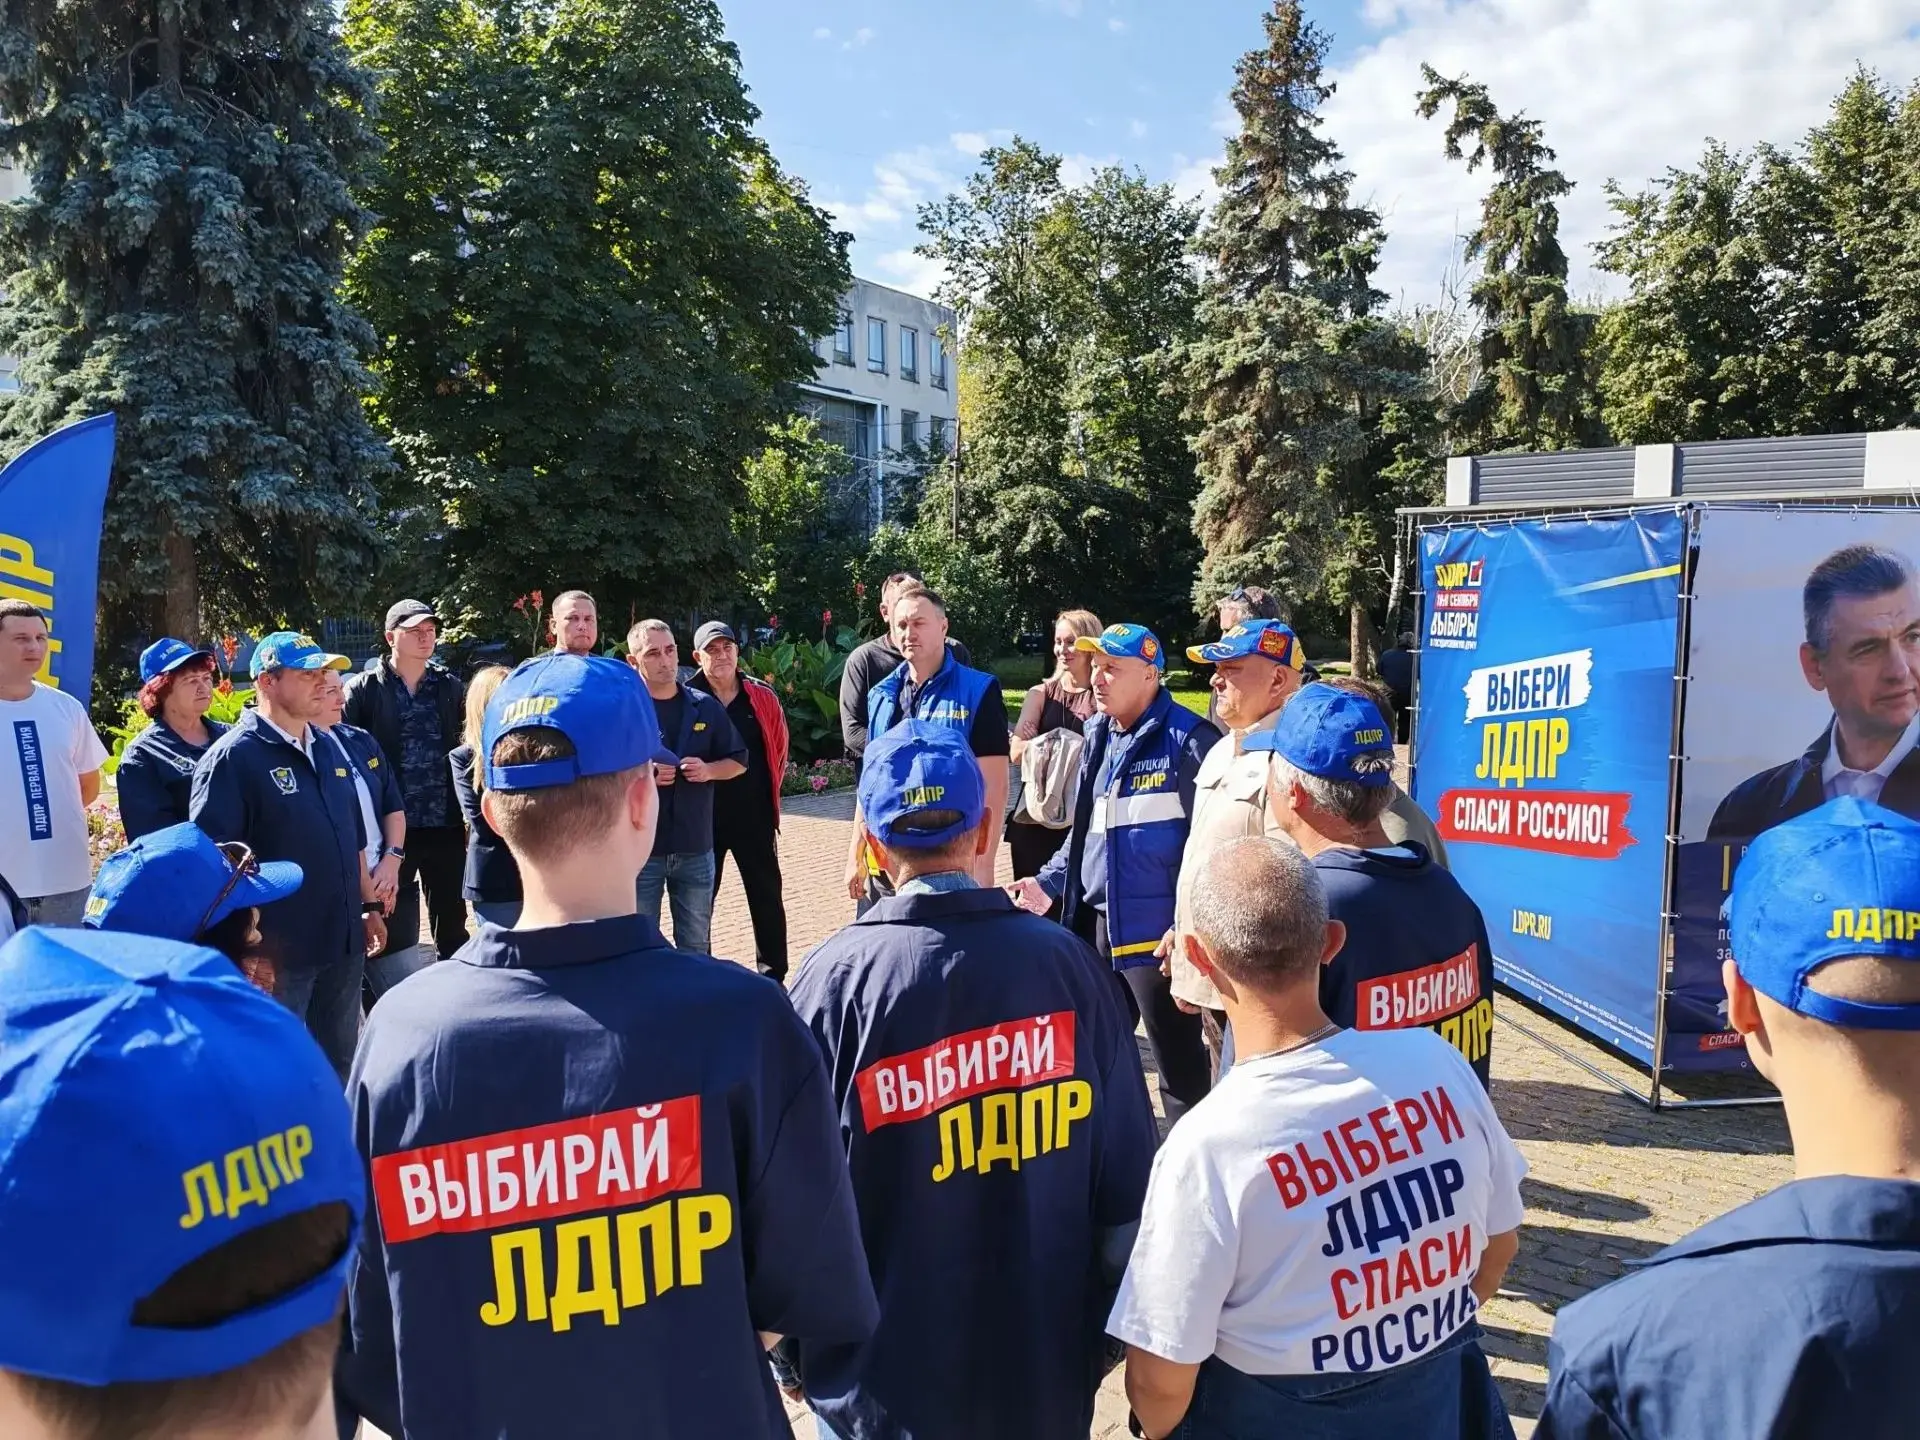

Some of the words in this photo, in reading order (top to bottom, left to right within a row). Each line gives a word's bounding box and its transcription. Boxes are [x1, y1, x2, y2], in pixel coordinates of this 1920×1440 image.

[1430, 611, 1479, 638] ВЫБОРЫ
[1486, 663, 1571, 712] ВЫБЕРИ
[500, 696, 558, 724] ЛДПР
[20, 726, 37, 763] ПАРТИЯ
[1354, 729, 1384, 745] ЛДПР
[1475, 717, 1570, 788] ЛДПР
[26, 763, 43, 799] ПЕРВАЯ
[1130, 755, 1170, 774] СЛУЦКИЙ
[1131, 772, 1167, 790] ЛДПР
[902, 785, 945, 807] ЛДПР
[33, 803, 48, 833] ЛДПР
[1454, 796, 1510, 834] СПАСИ
[1517, 799, 1610, 845] РОССИЮ!
[1512, 909, 1552, 941] LDPR.RU
[1826, 907, 1920, 944] ЛДПР
[1370, 950, 1476, 1027] ВЫБИРАЙ
[1709, 1033, 1741, 1047] СПАСИ
[874, 1014, 1055, 1115] ВЫБИРАЙ
[932, 1080, 1092, 1182] ЛДПР
[1266, 1086, 1466, 1210] ВЫБЕРИ
[179, 1125, 313, 1229] ЛДПР
[399, 1103, 669, 1226] ВЫБИРАЙ
[1321, 1158, 1465, 1257] ЛДПР
[480, 1193, 732, 1332] ЛДПР
[1330, 1224, 1471, 1320] СПАСИ
